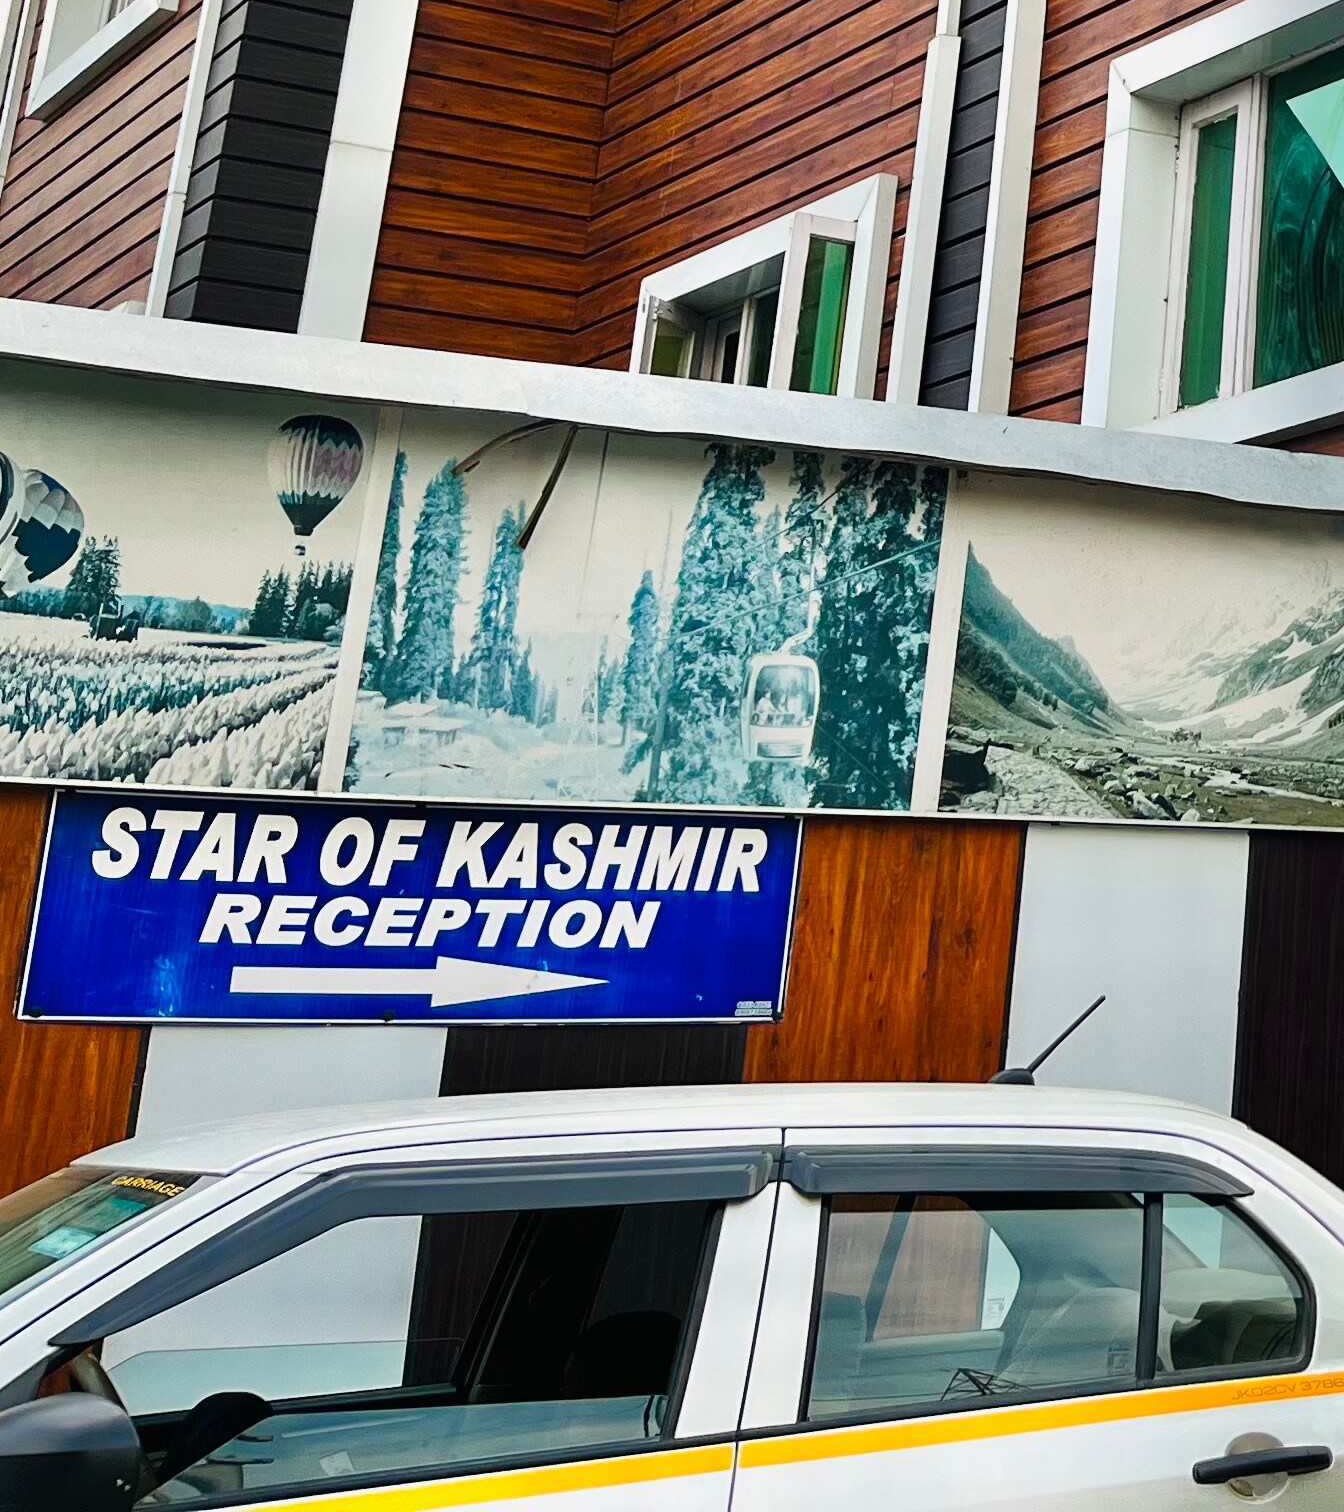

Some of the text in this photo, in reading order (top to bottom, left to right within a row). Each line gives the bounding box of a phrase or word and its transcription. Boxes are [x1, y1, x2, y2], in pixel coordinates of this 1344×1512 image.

[92, 806, 768, 892] STAR OF KASHMIR
[199, 893, 660, 949] RECEPTION
[111, 1175, 185, 1197] CARRIAGE
